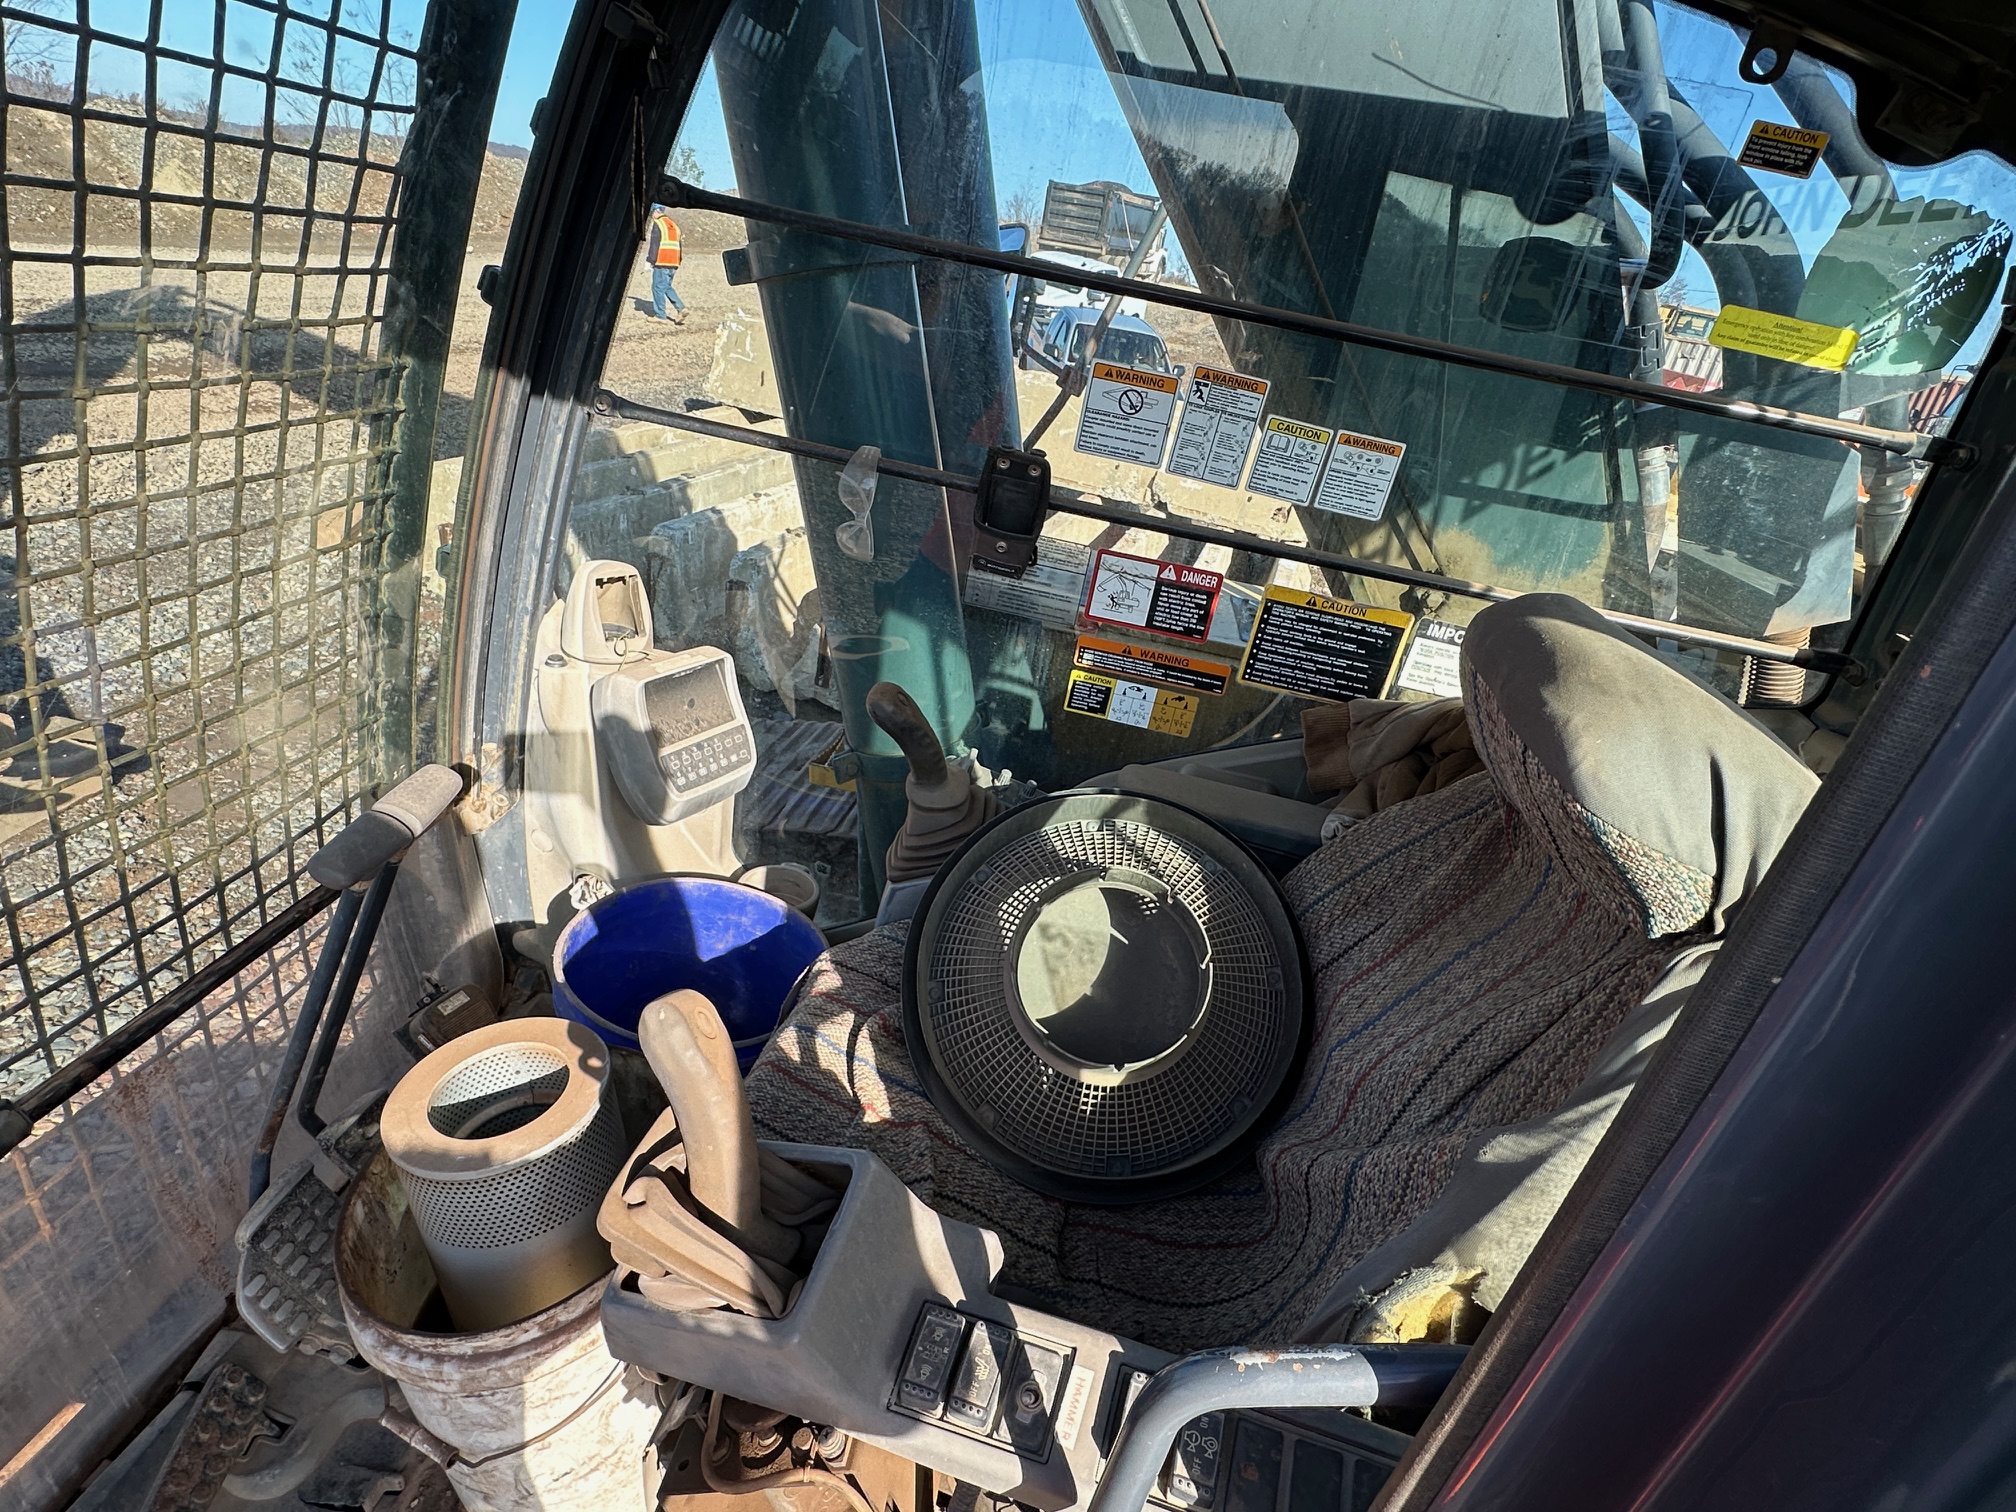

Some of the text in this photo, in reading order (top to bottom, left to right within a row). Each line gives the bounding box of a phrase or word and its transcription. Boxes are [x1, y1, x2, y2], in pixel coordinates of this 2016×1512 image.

[1773, 126, 1819, 144] CAUTION
[1115, 369, 1165, 389] WARNING
[1212, 372, 1258, 391] WARNING
[1276, 422, 1322, 440] CAUTION
[1352, 438, 1396, 455] WARNING
[1181, 570, 1218, 588] DANGER
[1321, 600, 1368, 618] CAUTION
[1426, 623, 1465, 643] IMPO
[1140, 649, 1190, 667] WARNING
[1083, 673, 1112, 685] CAUTION
[968, 1379, 981, 1398] OFF
[1061, 1376, 1086, 1441] HAMMER
[1200, 1415, 1209, 1429] ON
[1191, 1456, 1202, 1475] OFF
